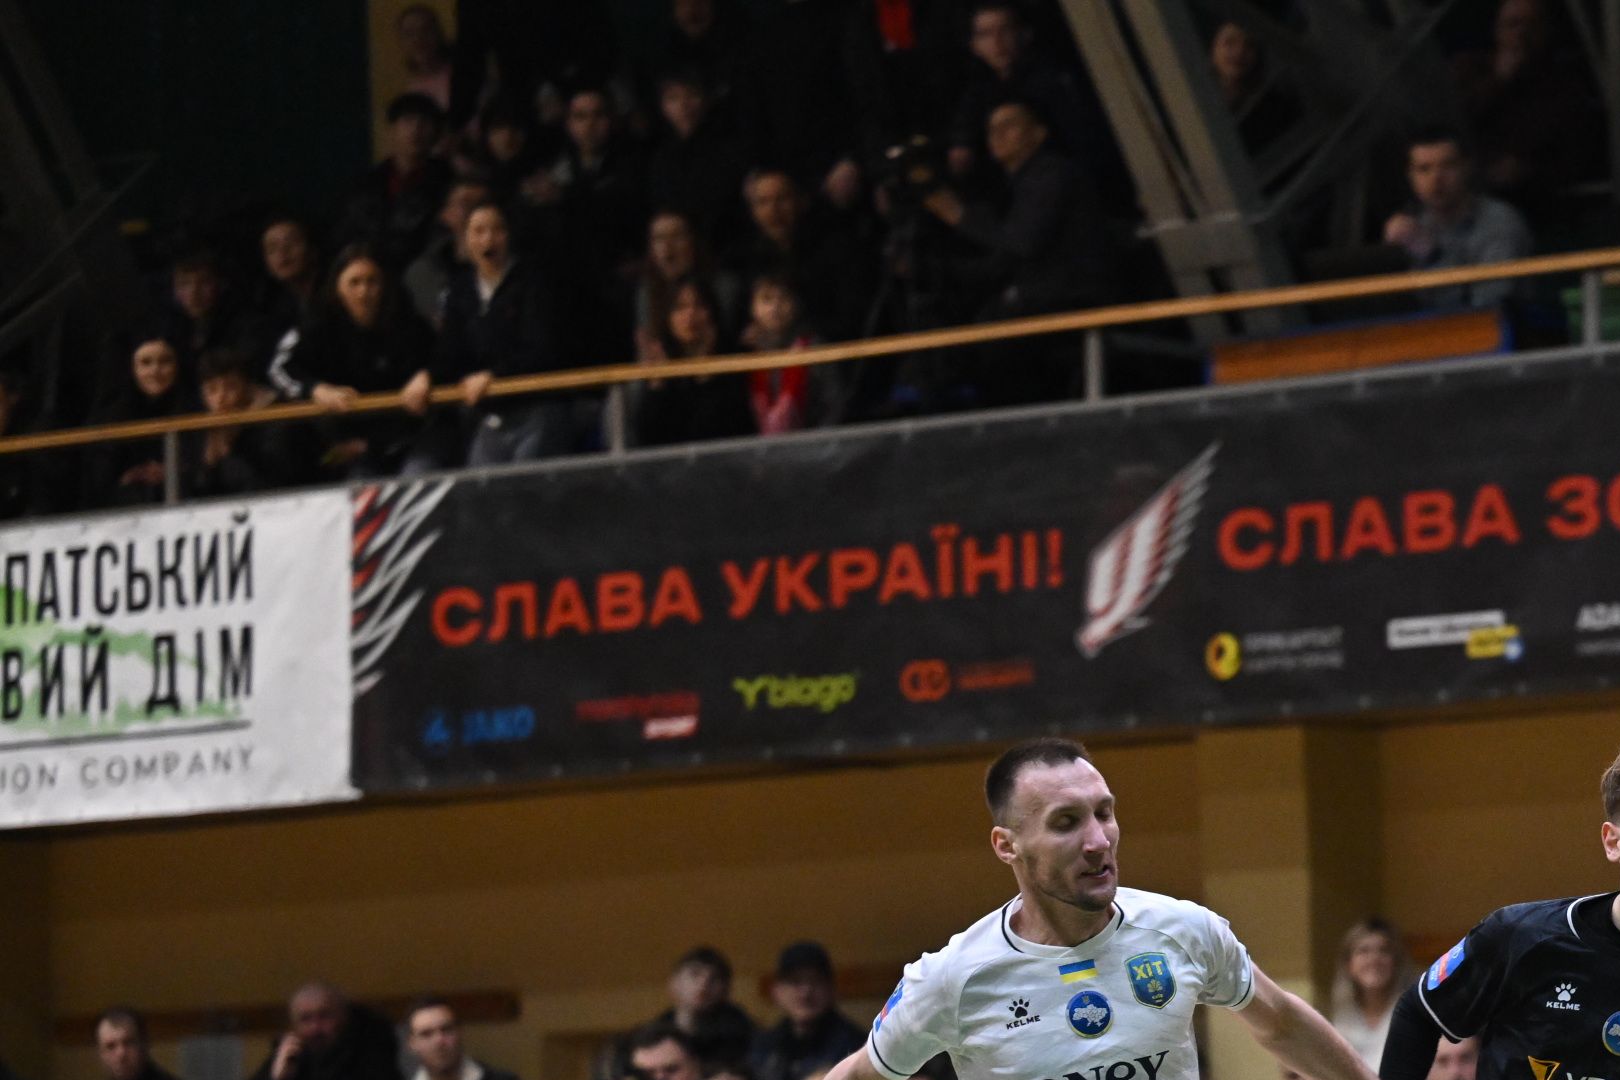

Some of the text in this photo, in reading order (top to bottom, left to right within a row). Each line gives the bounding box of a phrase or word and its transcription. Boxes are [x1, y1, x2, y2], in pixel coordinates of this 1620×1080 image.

[4, 508, 254, 627] ПАТСЬКИЙ
[1216, 483, 1521, 571] СЛАВА
[431, 524, 1064, 647] СЛАВА УКРАЇНІ!
[1, 621, 254, 723] ВИЙ ДІМ
[80, 746, 253, 790] COMPANY
[1006, 1014, 1041, 1030] KELME
[1546, 1001, 1581, 1011] KELME
